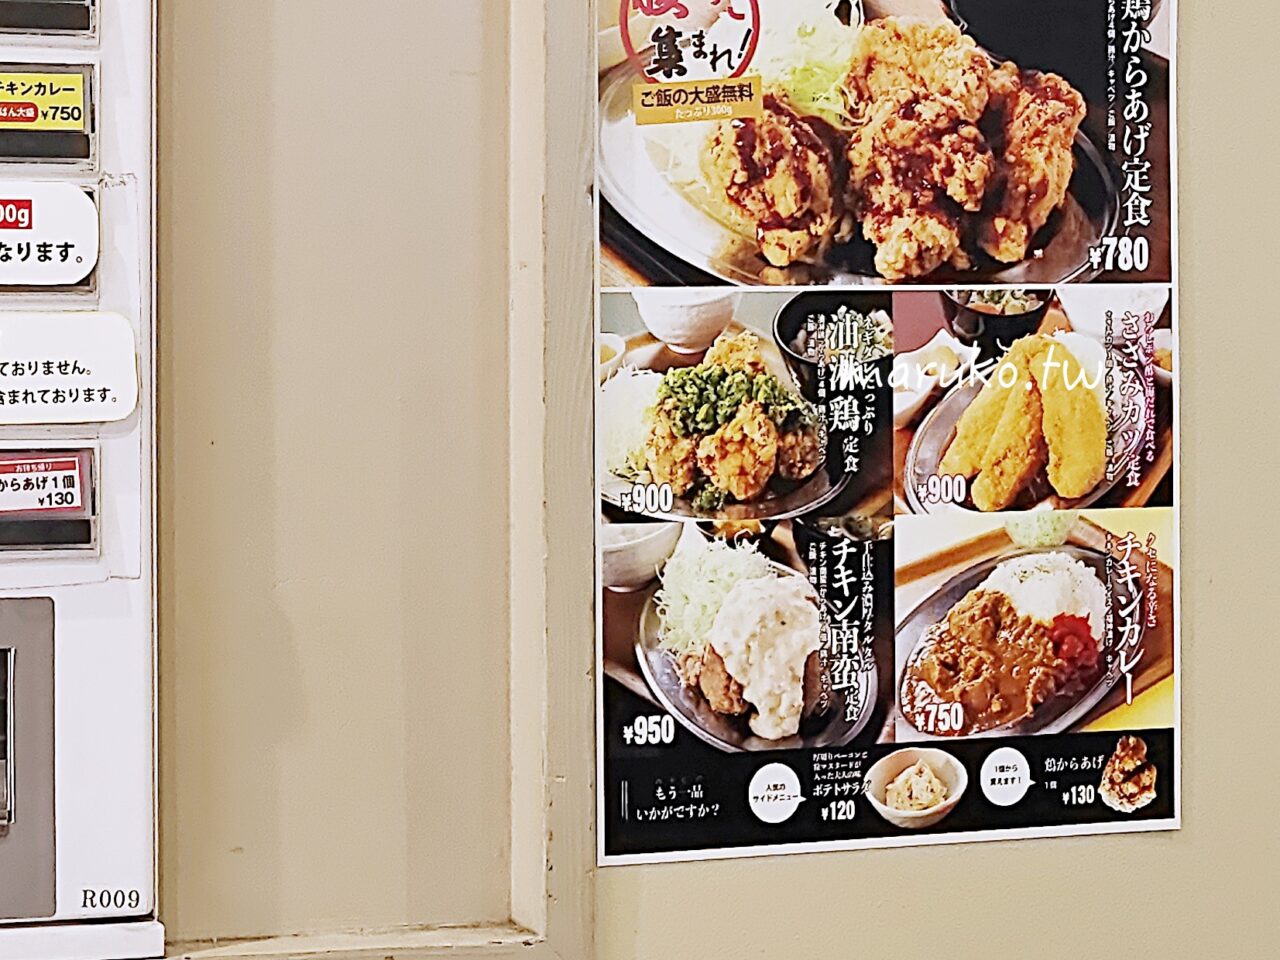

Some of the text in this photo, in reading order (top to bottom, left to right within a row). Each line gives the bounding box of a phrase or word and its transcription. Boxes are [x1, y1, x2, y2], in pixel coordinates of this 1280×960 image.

[640, 83, 754, 107] ご飯の大盛無料
[41, 106, 81, 121] ¥750
[1089, 236, 1149, 271] ¥780
[1121, 311, 1142, 487] ささみカツ定食
[38, 492, 74, 506] ¥130
[621, 484, 674, 513] ¥900
[917, 474, 966, 503] ¥900
[1115, 532, 1144, 706] チキンカレー
[623, 715, 675, 745] ¥950
[915, 703, 963, 732] ¥750
[1044, 754, 1105, 773] 鶏からあげ
[1062, 785, 1095, 805] ¥130
[821, 800, 855, 820] ¥120
[81, 888, 140, 910] R009
